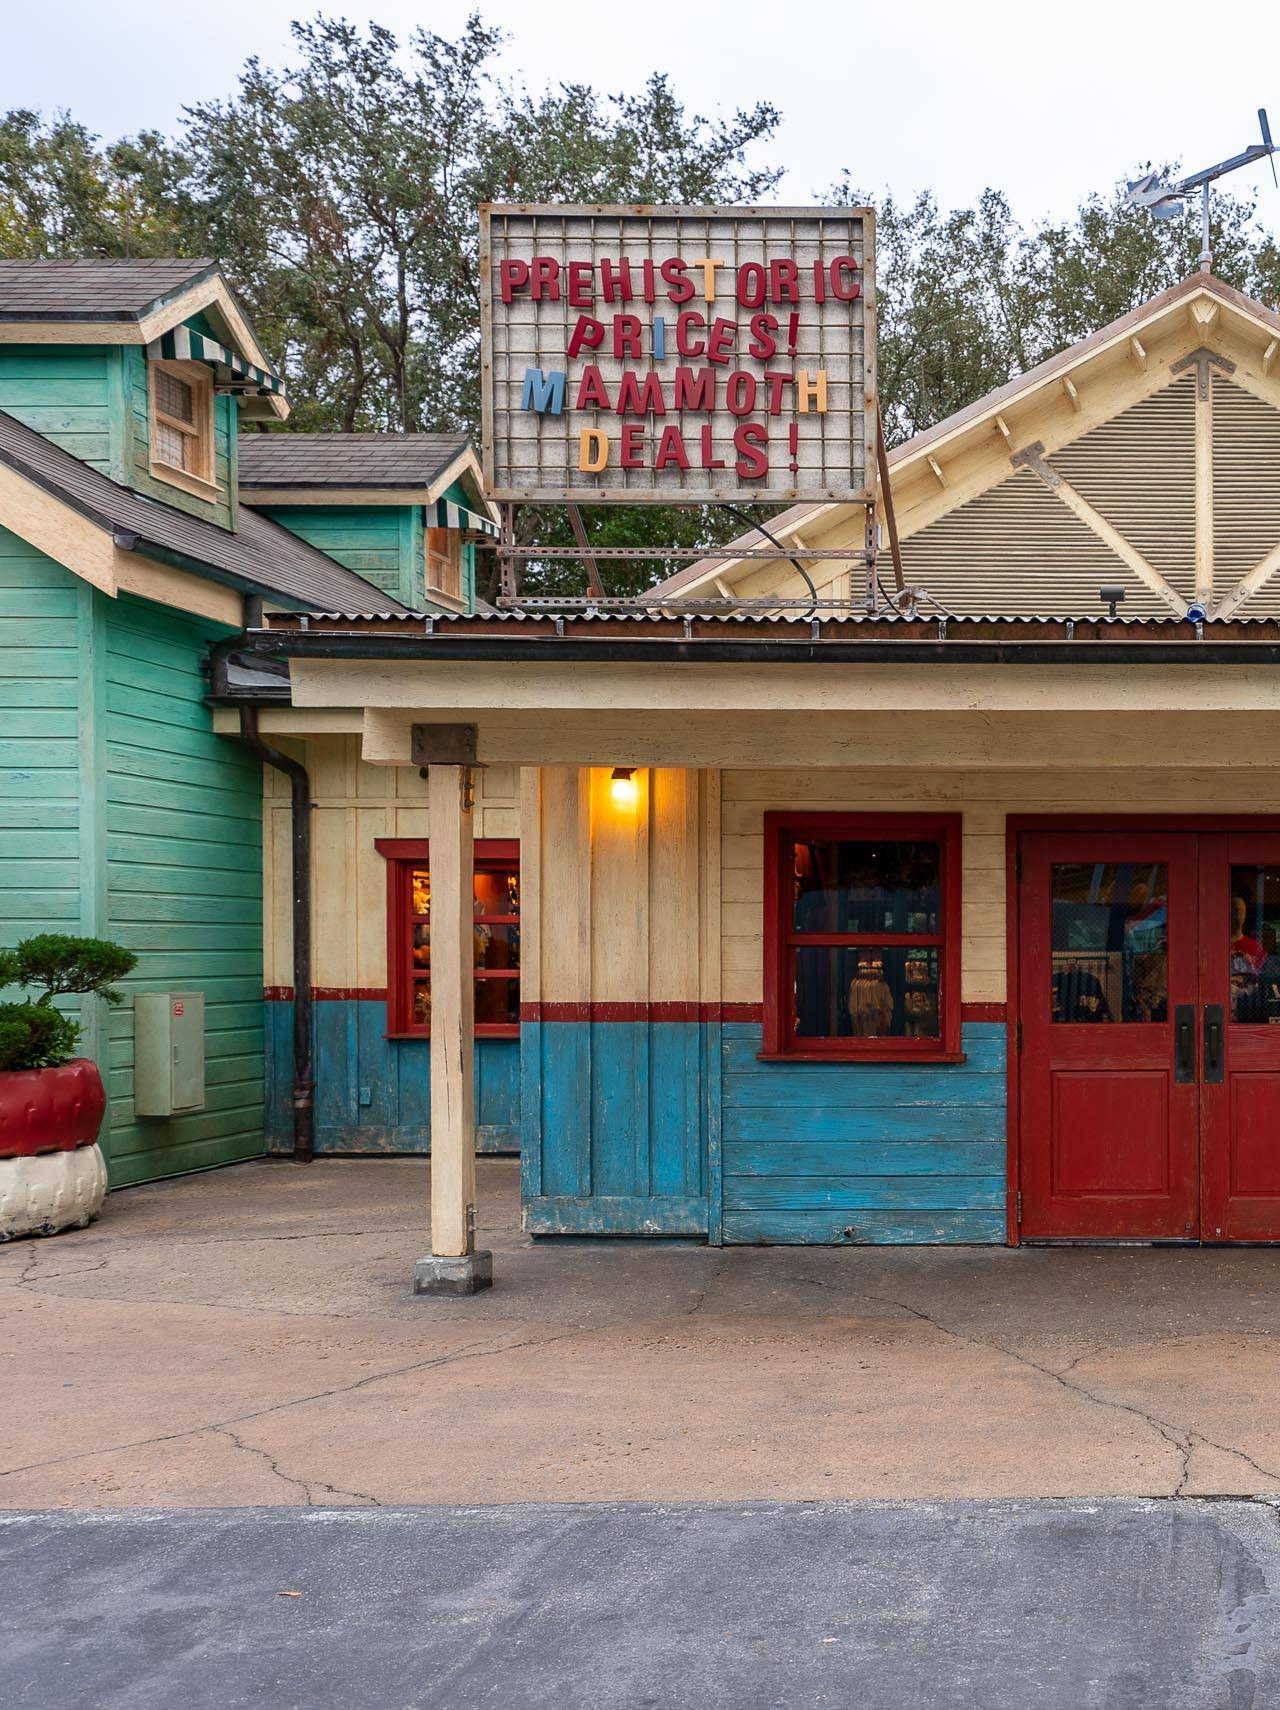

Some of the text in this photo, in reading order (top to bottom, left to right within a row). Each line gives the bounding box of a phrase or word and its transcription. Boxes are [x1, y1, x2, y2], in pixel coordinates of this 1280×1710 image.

[500, 255, 861, 308] PREHISTORIC
[566, 311, 800, 365] PRICES!
[520, 365, 828, 417] MAMMOTH
[578, 422, 800, 480] DEALS!
